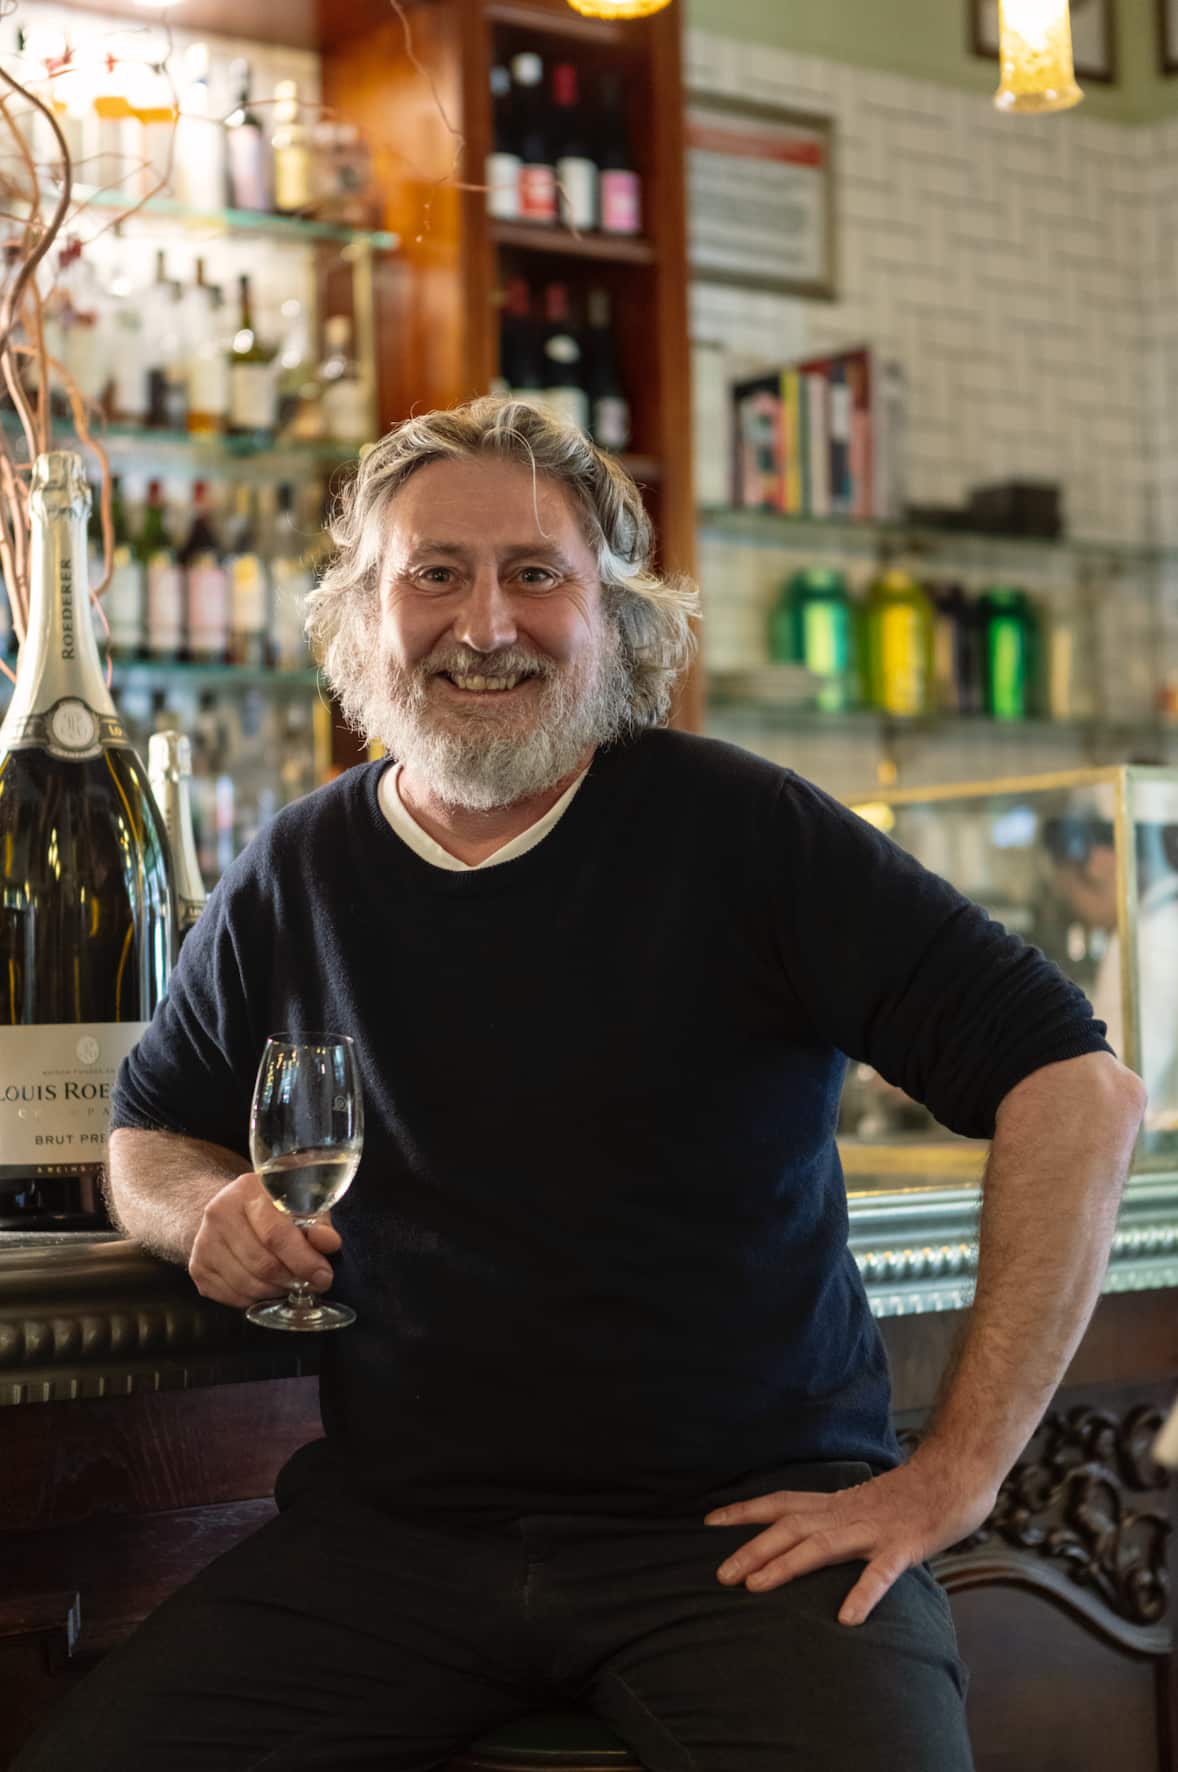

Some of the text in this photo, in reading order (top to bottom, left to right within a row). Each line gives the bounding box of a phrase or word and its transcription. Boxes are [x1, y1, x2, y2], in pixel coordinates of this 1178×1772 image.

[61, 558, 73, 660] ROEDERER
[64, 1082, 109, 1100] ROE
[34, 1135, 73, 1145] BRUT
